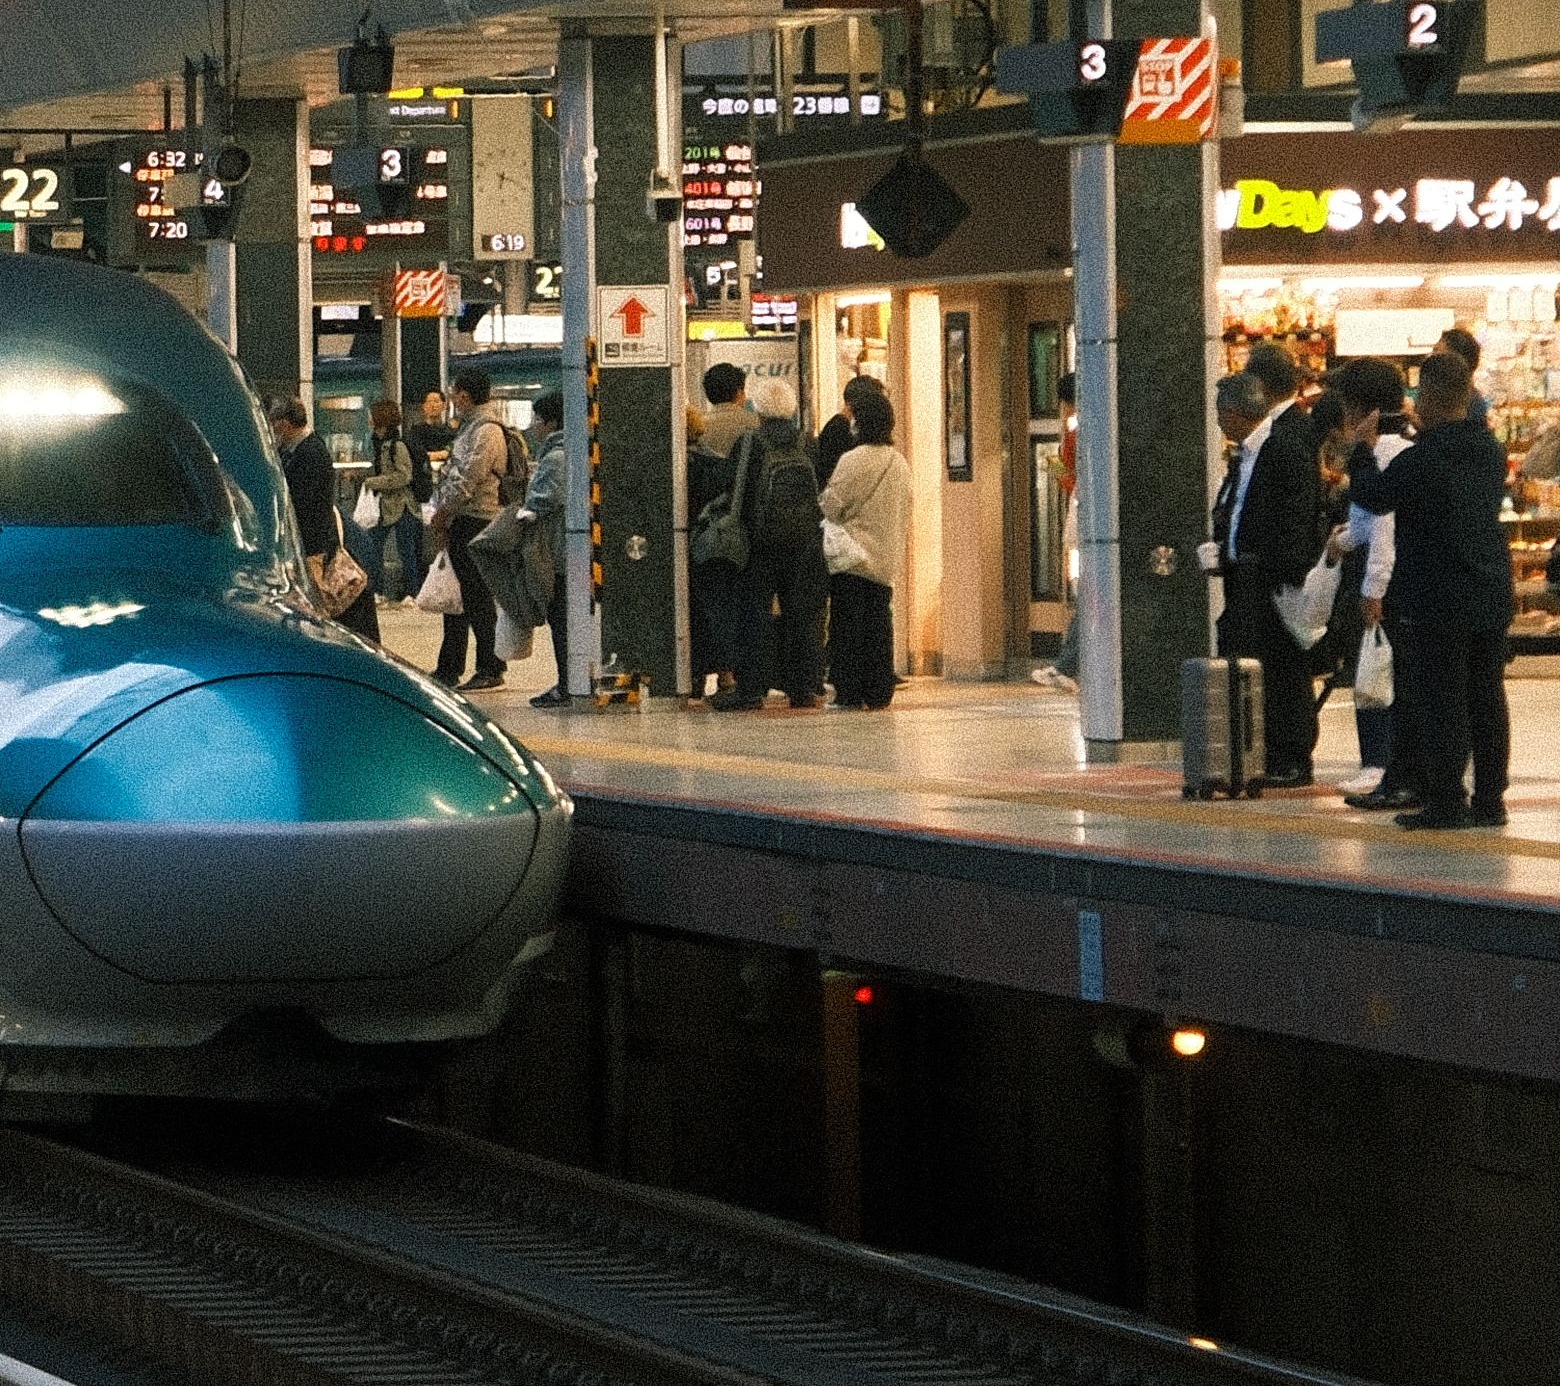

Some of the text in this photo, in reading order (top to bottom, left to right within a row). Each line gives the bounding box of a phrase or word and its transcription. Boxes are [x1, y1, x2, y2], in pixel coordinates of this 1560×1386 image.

[1409, 3, 1438, 44] 2
[1081, 44, 1107, 80] 3
[147, 150, 186, 168] 6:32
[380, 149, 403, 178] 3
[0, 167, 60, 212] 22
[203, 178, 225, 201] 4
[148, 221, 188, 239] 7:20
